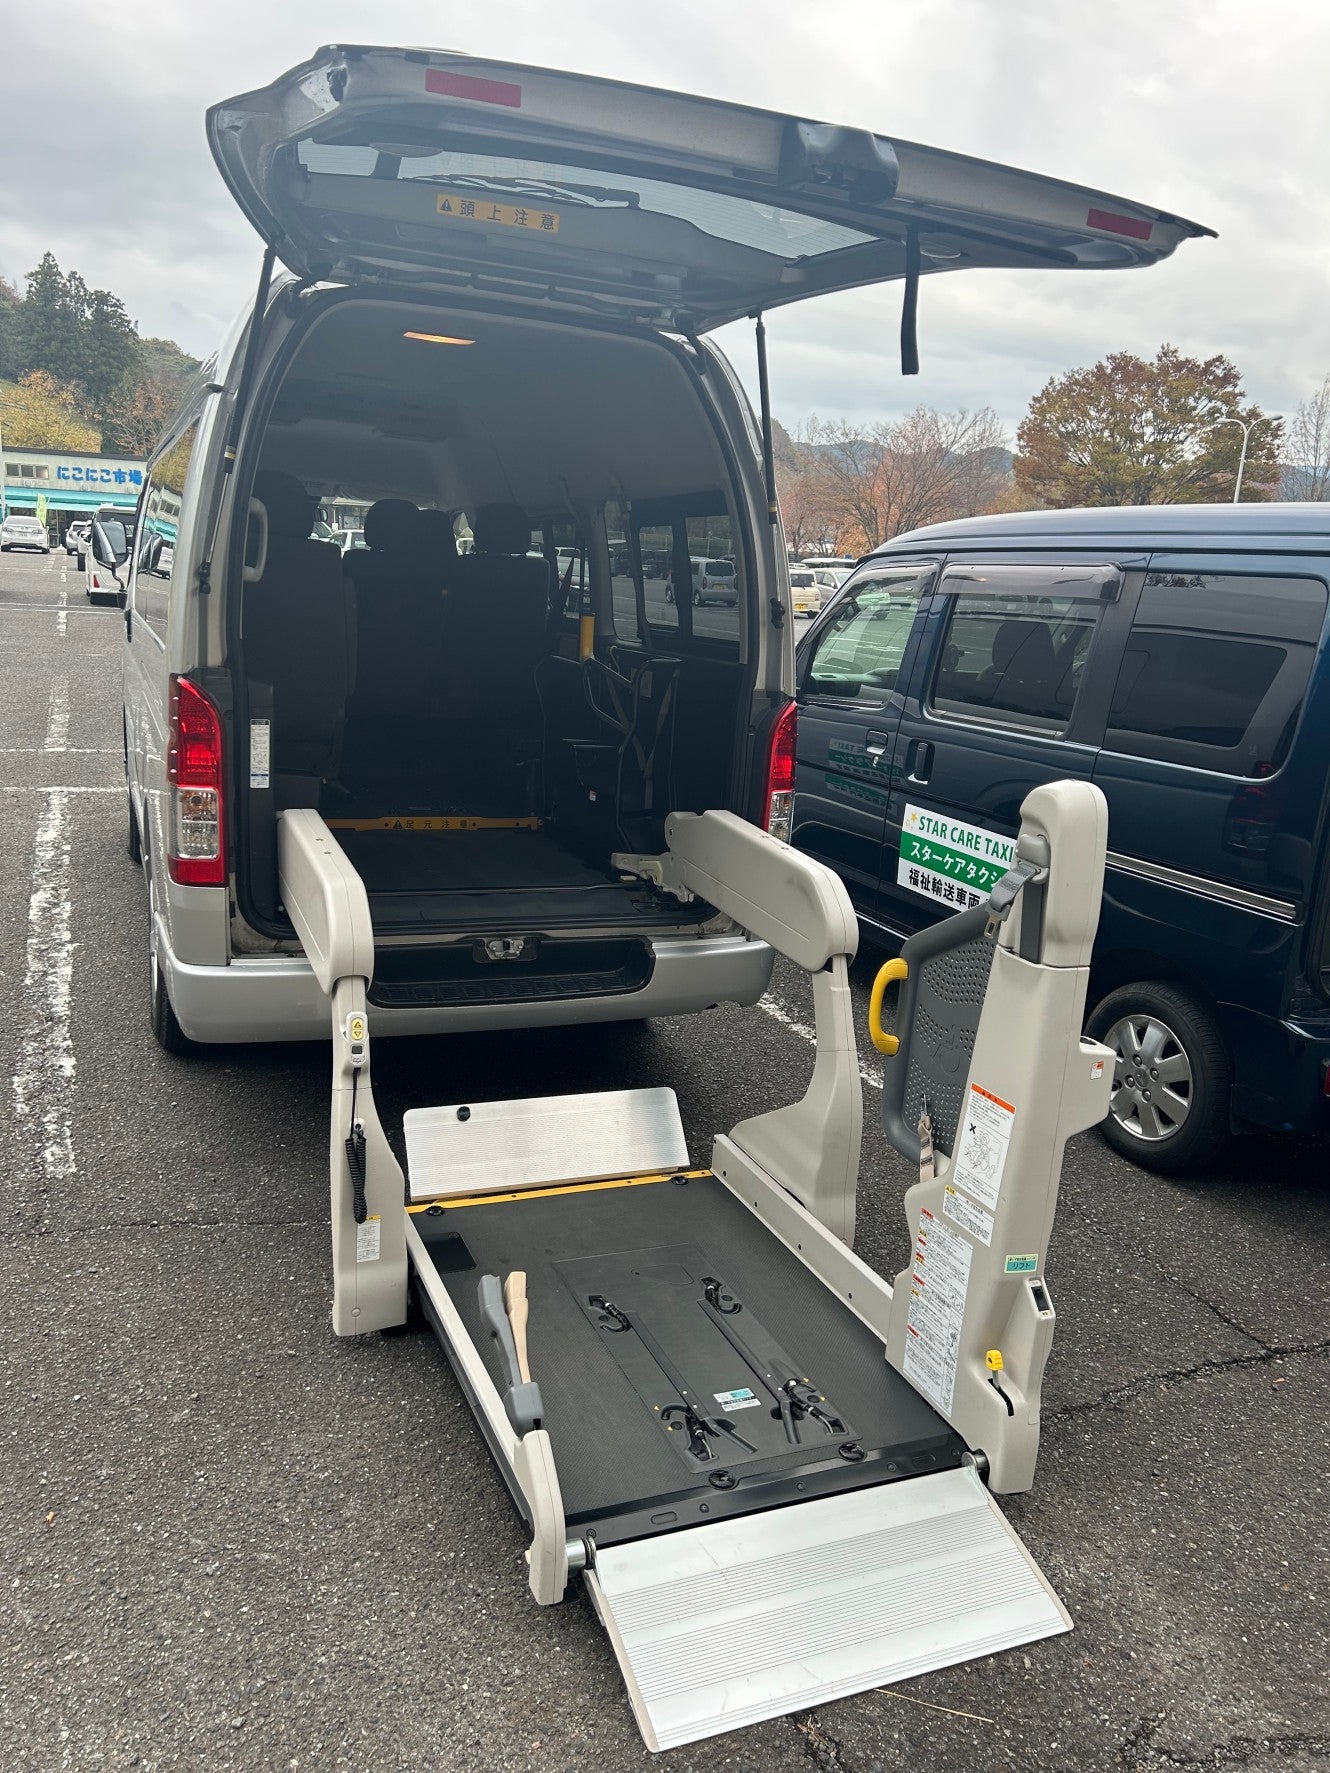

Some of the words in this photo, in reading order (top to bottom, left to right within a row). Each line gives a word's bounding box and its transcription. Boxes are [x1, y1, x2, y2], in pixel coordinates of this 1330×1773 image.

[459, 199, 555, 230] 頭上注意
[57, 465, 143, 486] にこにこ市場
[918, 815, 948, 839] STAR
[950, 826, 982, 851] CARE
[984, 837, 1014, 863] TAXI
[1013, 1262, 1031, 1270] リフト
